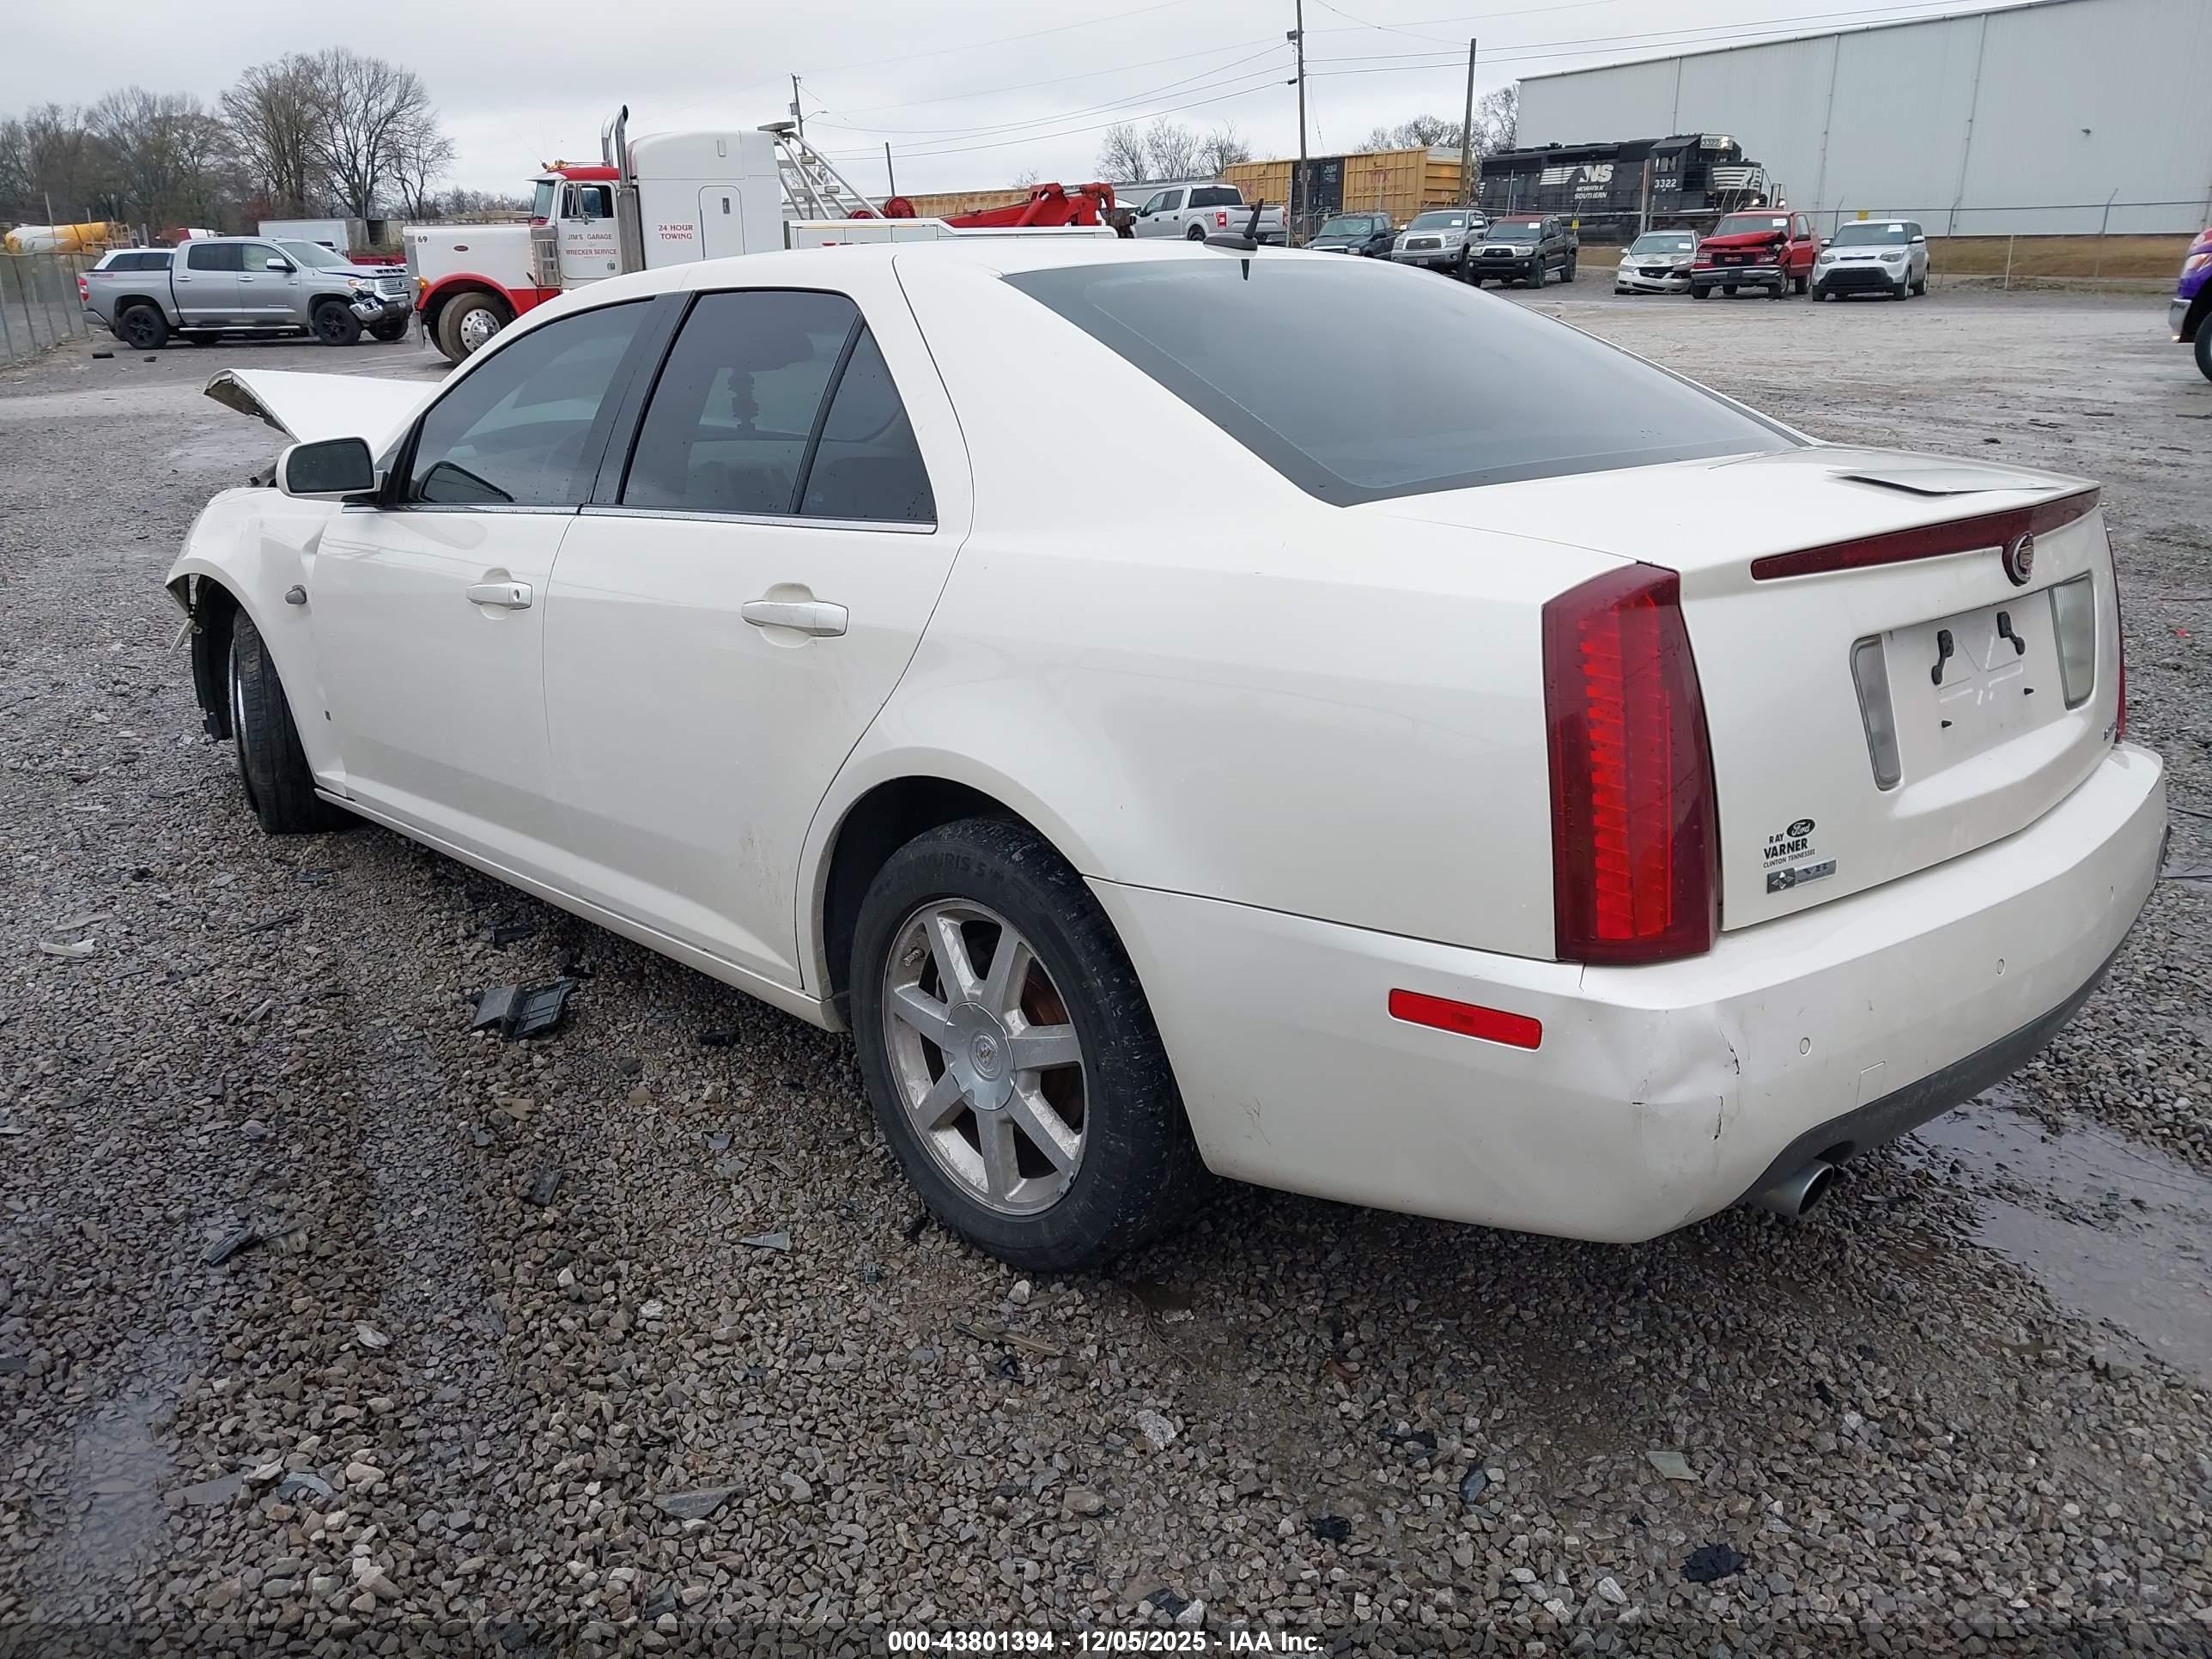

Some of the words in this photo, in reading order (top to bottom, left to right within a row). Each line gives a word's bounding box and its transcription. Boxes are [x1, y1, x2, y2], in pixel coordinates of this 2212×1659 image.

[1654, 179, 1677, 189] 3322
[1574, 191, 1608, 200] SOUTHERN
[1790, 821, 1812, 836] Ford
[1769, 832, 1784, 844] RAY
[1763, 837, 1808, 860] VARNER
[1763, 855, 1786, 868] CLINTON
[1788, 848, 1816, 862] TENNESSEE
